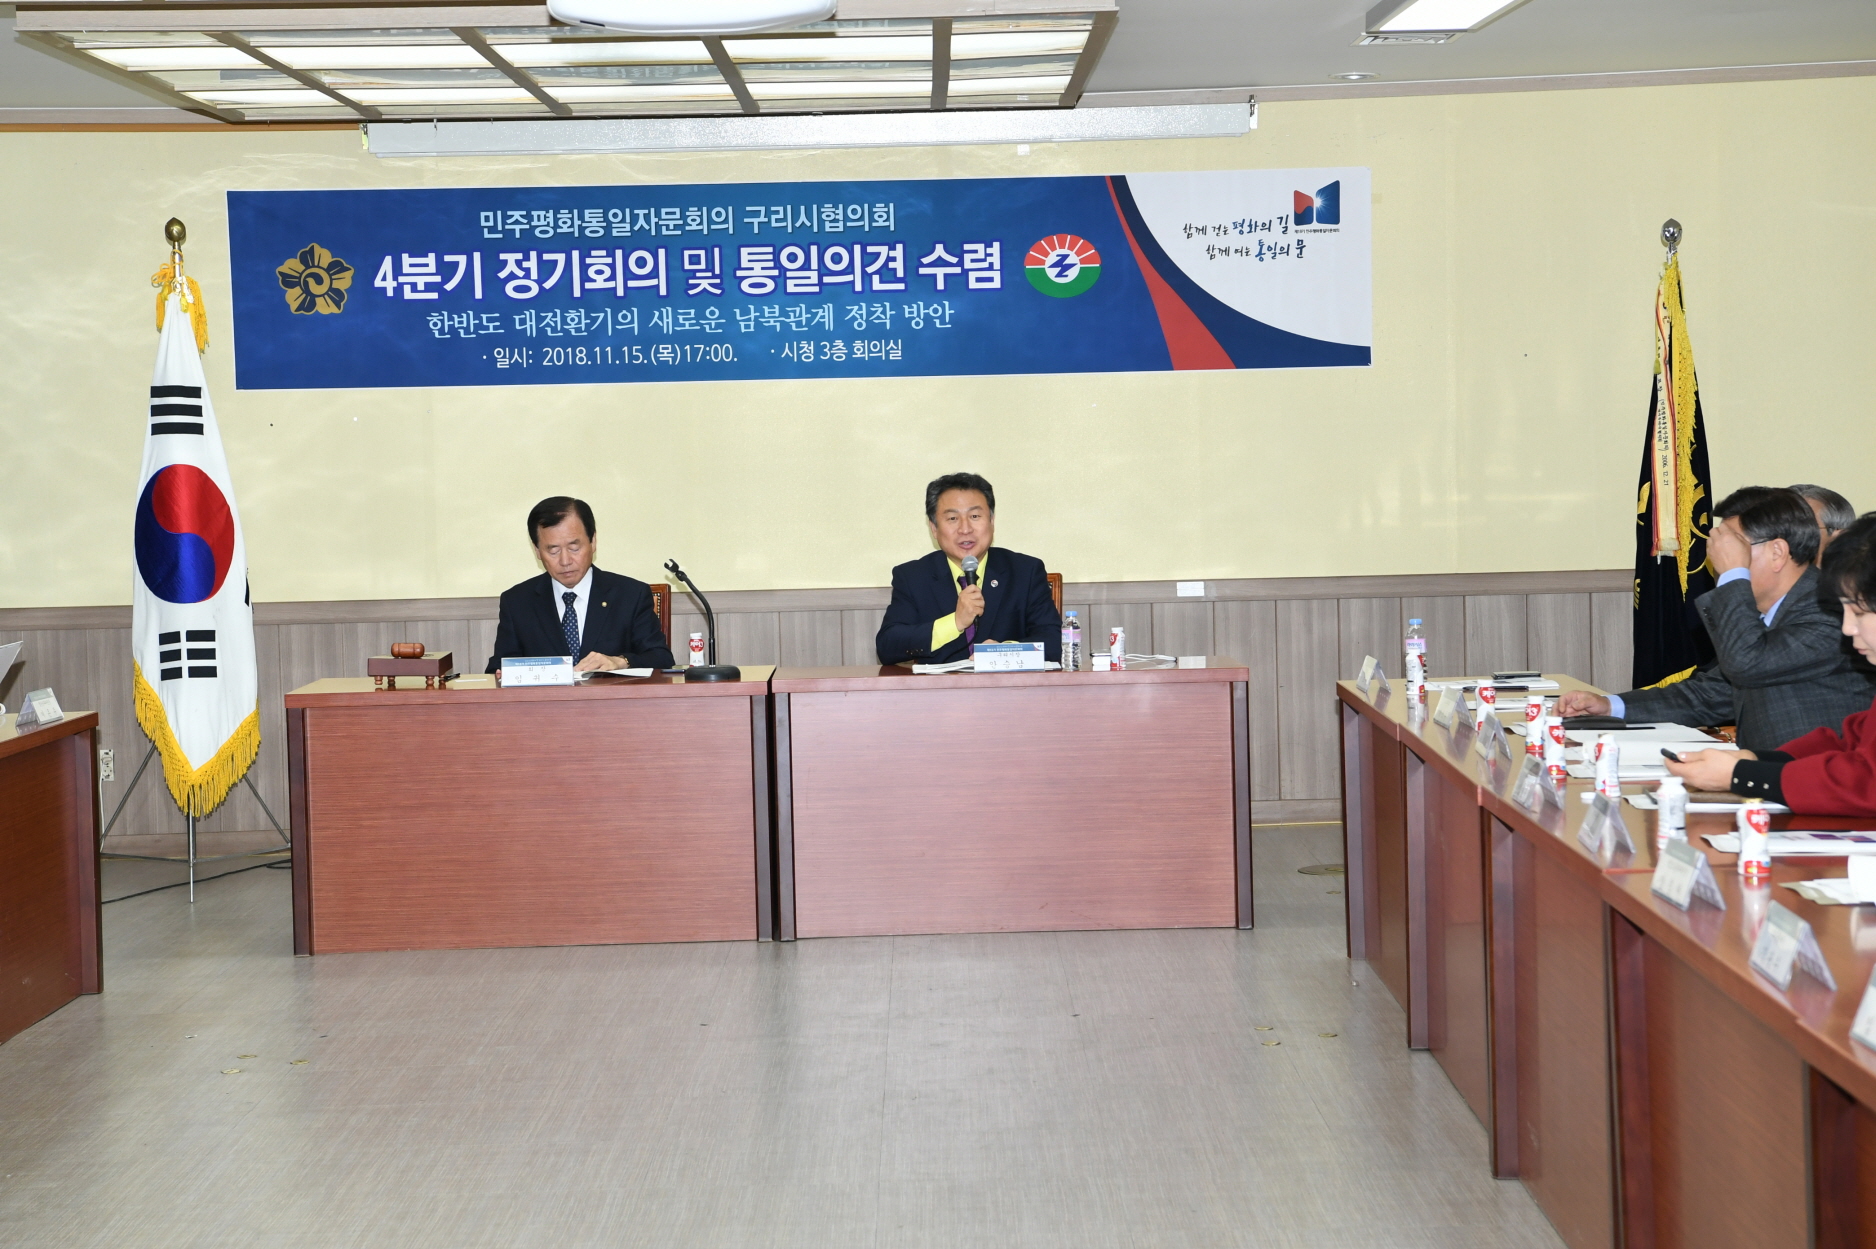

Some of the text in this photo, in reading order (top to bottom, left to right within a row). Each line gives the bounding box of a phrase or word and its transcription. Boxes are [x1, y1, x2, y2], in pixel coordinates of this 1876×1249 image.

[480, 202, 895, 239] 민주평화통일자문회의 구리시협의회
[1183, 223, 1208, 239] 함께
[1232, 218, 1273, 236] 평화의
[1276, 213, 1290, 235] 길
[1205, 244, 1230, 260] 함께
[1254, 239, 1291, 262] 통일의
[1295, 239, 1307, 259] 문
[373, 241, 1001, 300] 4분기 정기회의 및 통일의견 수렴
[426, 300, 955, 339] 한반도 대전환기의 새로운 남북관계 정착 방안
[781, 338, 902, 363] 시청 3층 회의실
